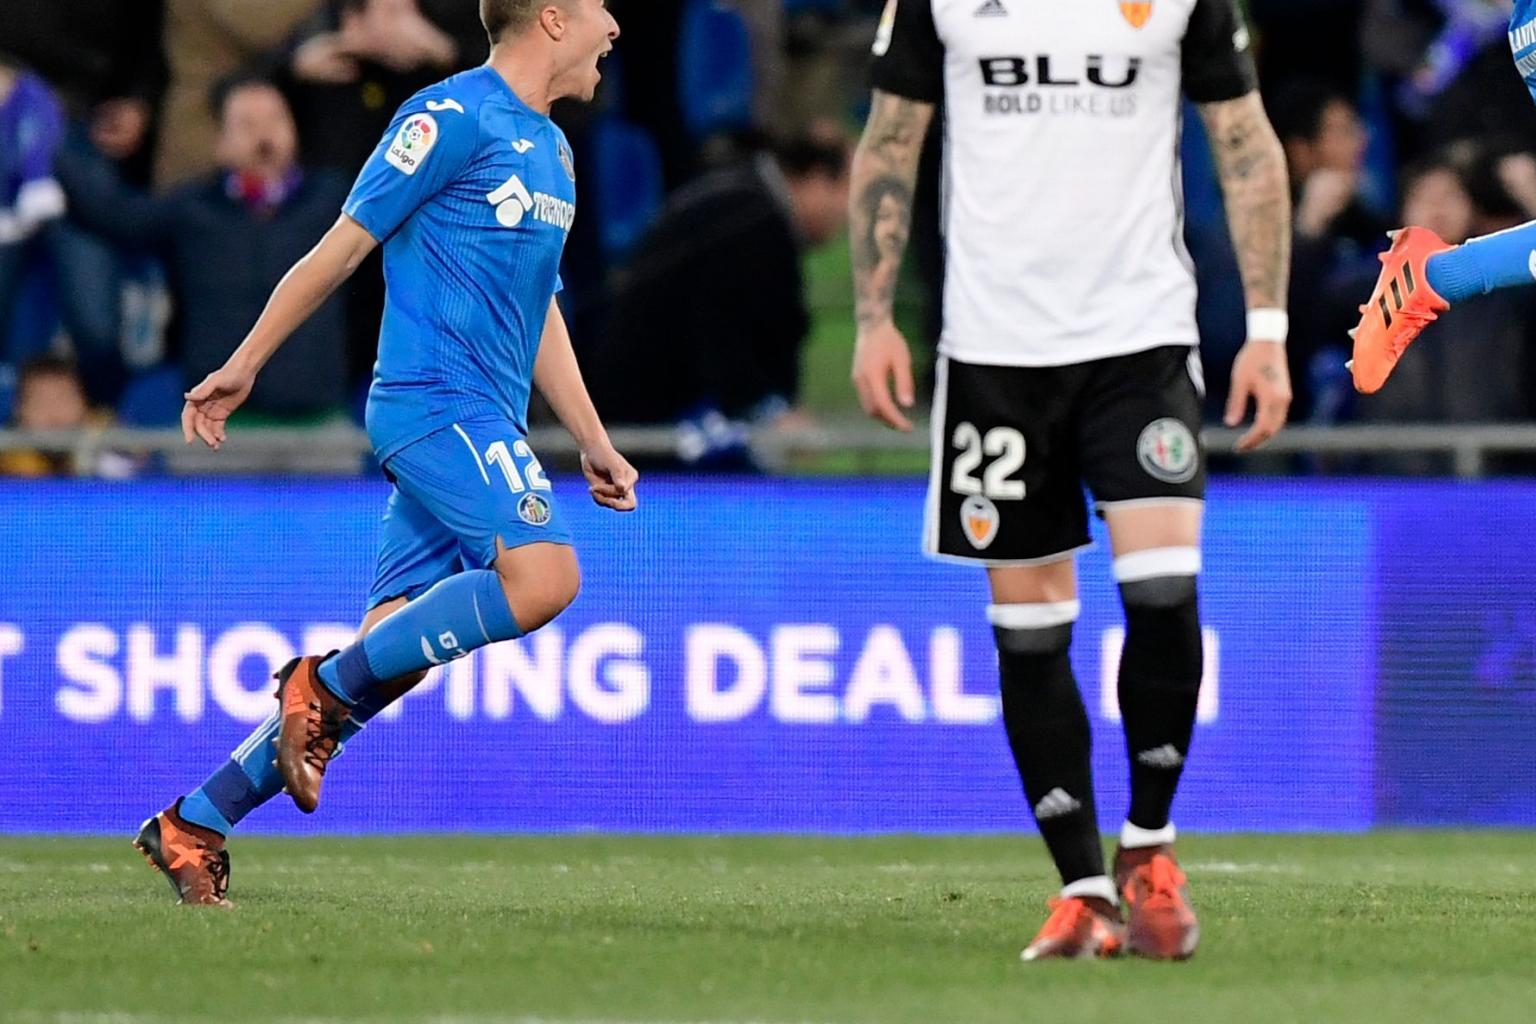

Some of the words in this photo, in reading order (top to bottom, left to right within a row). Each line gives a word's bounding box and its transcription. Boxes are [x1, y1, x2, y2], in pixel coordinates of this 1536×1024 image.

[983, 93, 1042, 116] BOLD
[1051, 93, 1102, 116] LIKE
[1110, 93, 1137, 117] US
[485, 440, 552, 494] 12
[950, 421, 1027, 501] 22
[56, 621, 652, 725] SHOING
[685, 622, 1000, 726] DEAL
